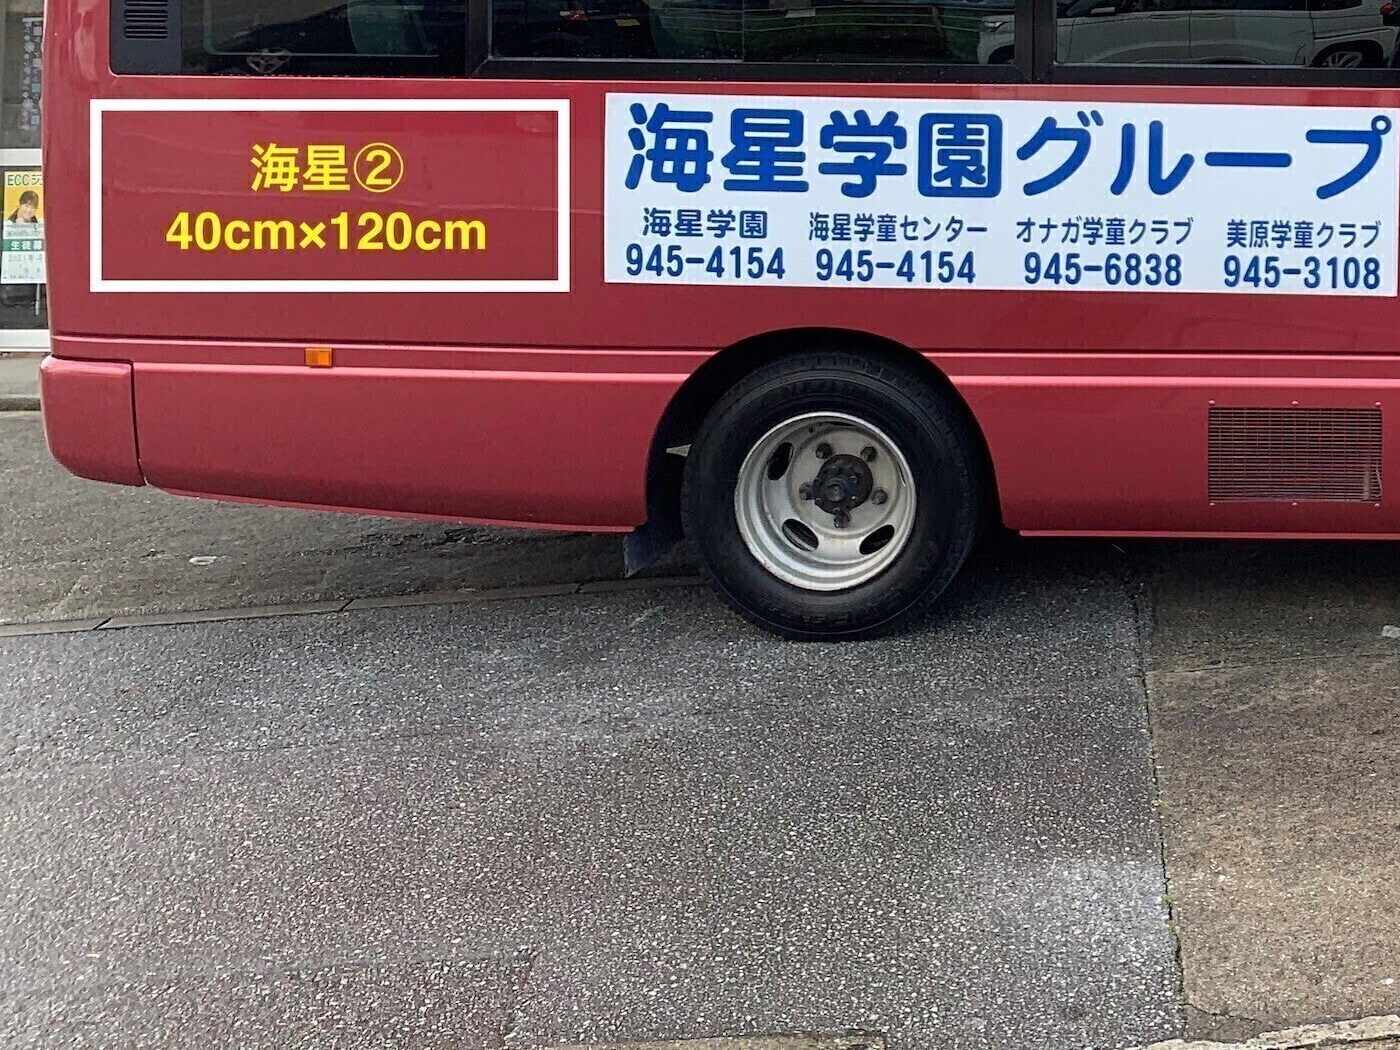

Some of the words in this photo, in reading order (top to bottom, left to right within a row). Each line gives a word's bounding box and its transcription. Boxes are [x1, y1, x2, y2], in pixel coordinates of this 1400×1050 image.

[624, 102, 1394, 201] 海星学園グループ
[642, 208, 769, 240] 海星学園
[808, 212, 988, 243] 海星学童センター
[1015, 216, 1194, 247] オナガ学童クラブ
[1225, 219, 1382, 250] 美原学童クラブ
[625, 243, 785, 281] 945-4154
[814, 248, 977, 285] 945-4154
[1022, 251, 1183, 288] 945-6838
[1222, 253, 1382, 291] 945-3108
